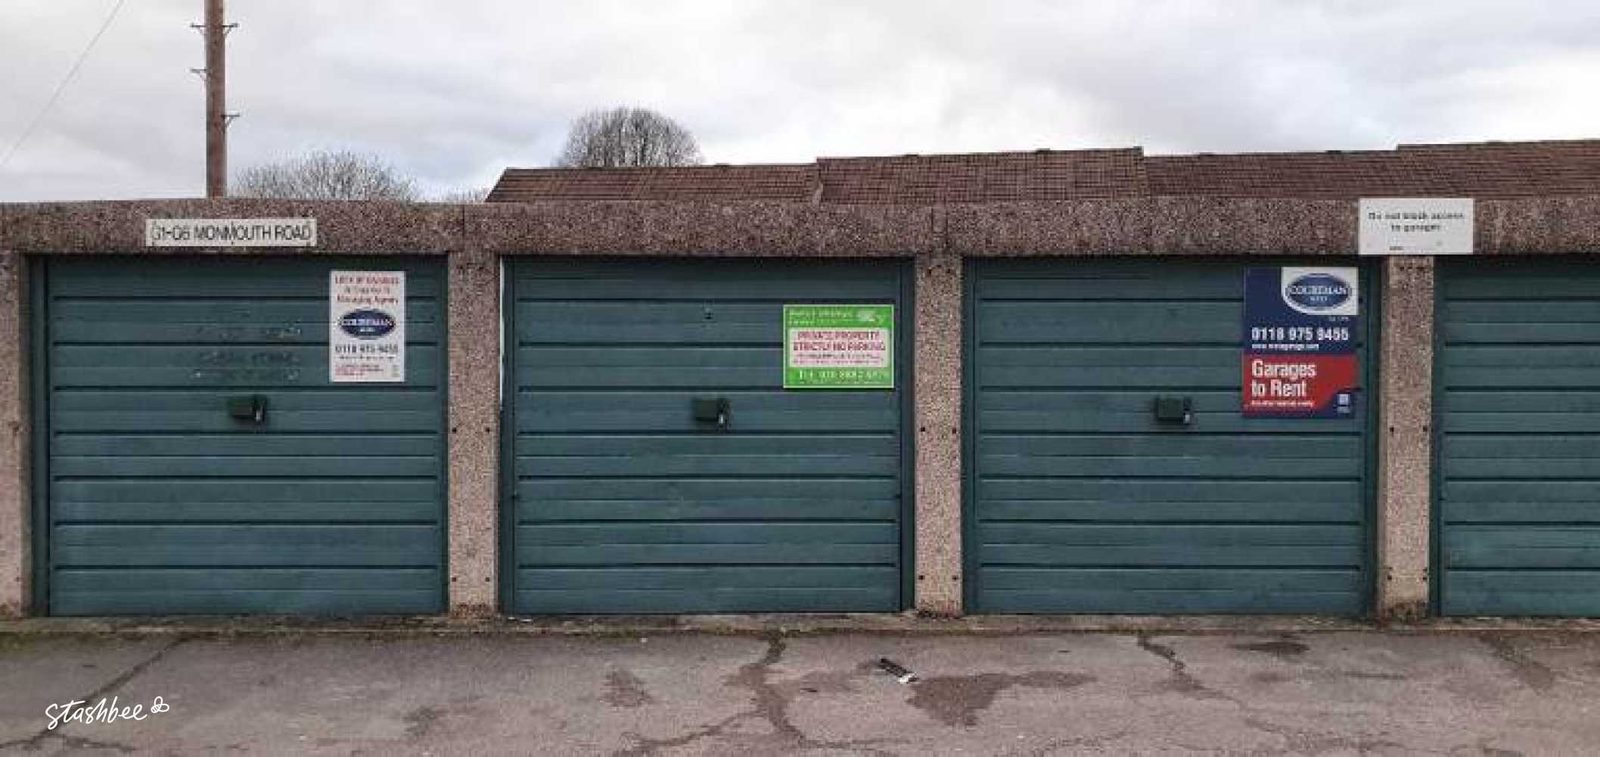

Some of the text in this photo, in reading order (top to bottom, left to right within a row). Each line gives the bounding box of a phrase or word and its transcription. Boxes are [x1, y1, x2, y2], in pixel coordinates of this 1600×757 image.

[194, 224, 272, 241] MONMOUTH
[275, 224, 311, 241] ROAD
[1251, 327, 1349, 341] 0118 975 9455
[1251, 359, 1317, 381] Garages
[1251, 379, 1307, 397] to Rent
